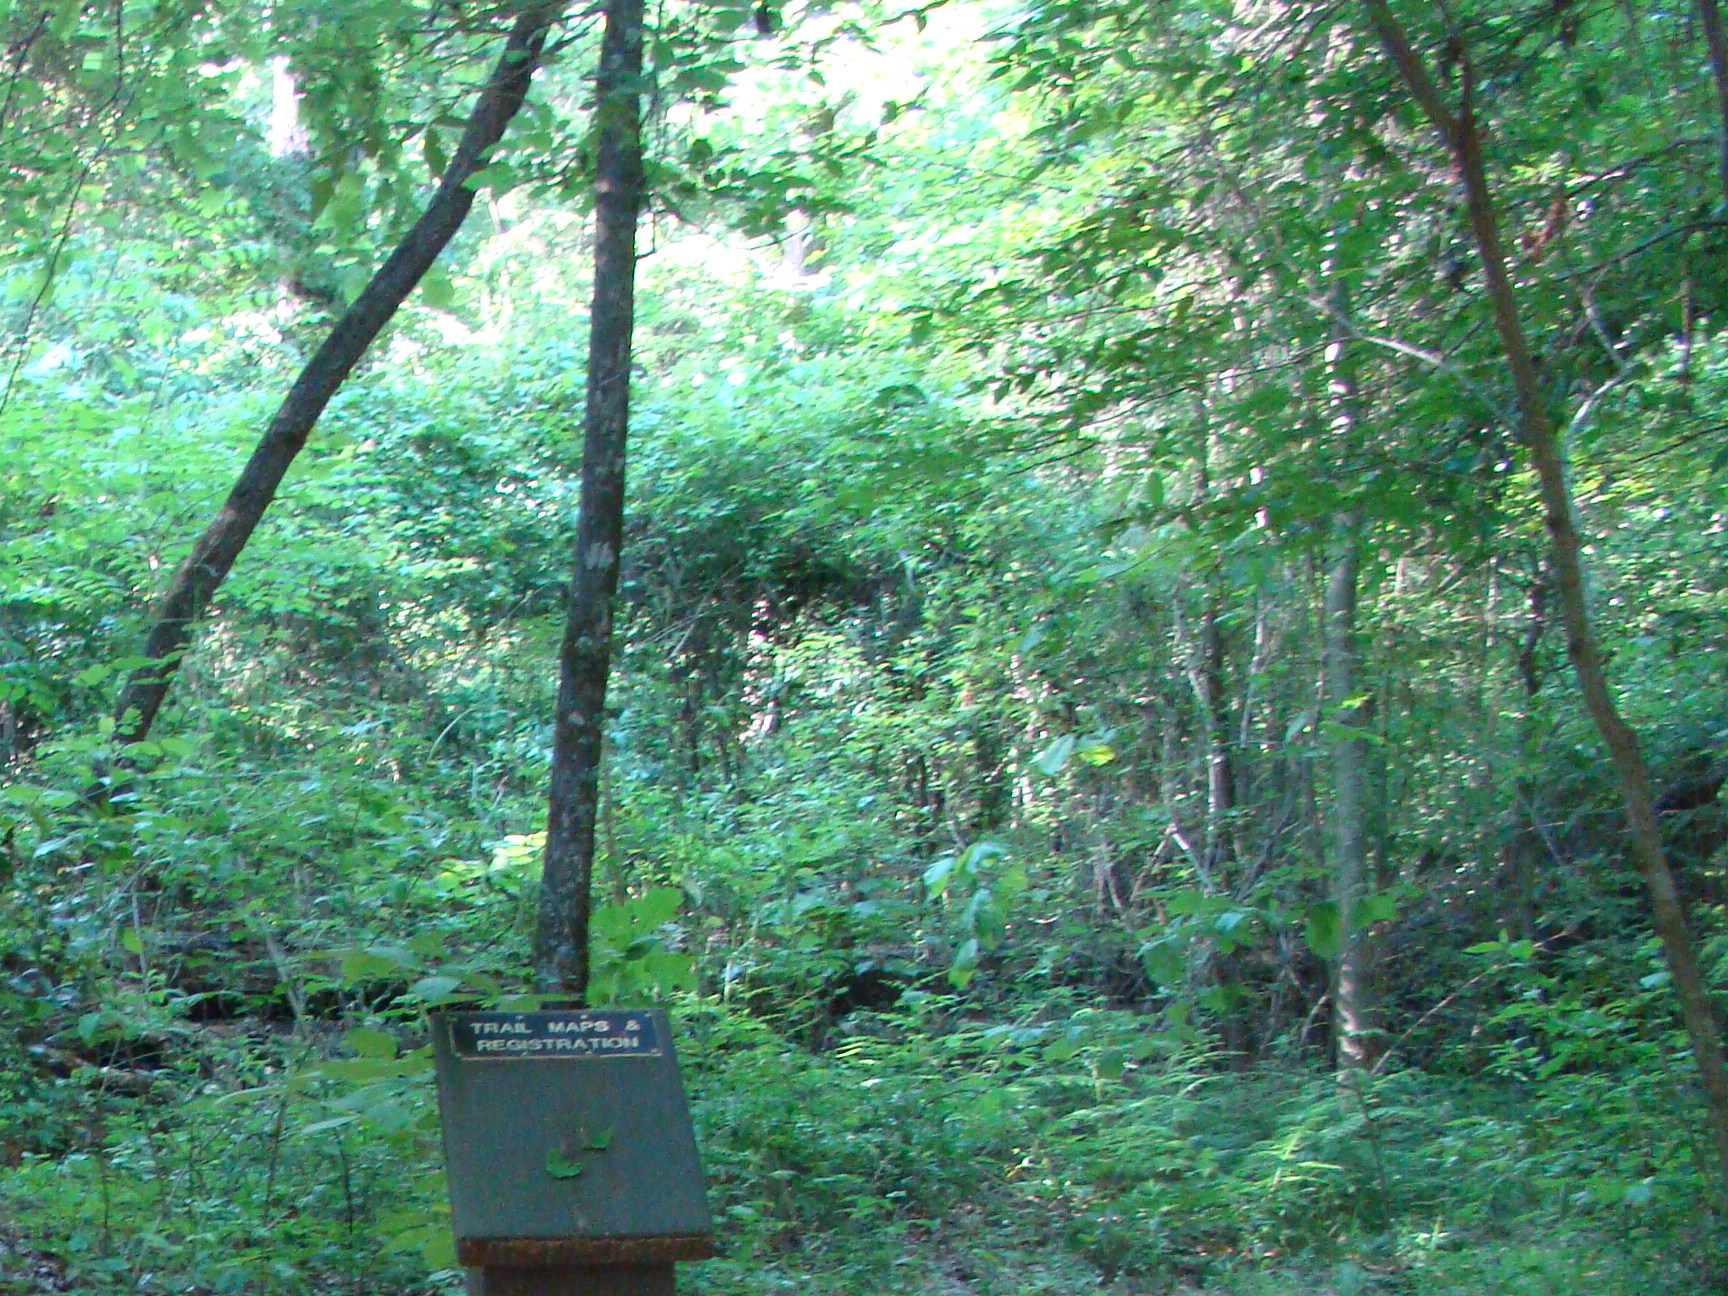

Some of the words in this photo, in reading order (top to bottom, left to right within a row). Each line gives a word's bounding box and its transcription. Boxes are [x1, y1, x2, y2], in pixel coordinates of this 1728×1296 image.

[470, 1022, 532, 1035] TRAIL
[547, 1020, 610, 1033] MAPS
[625, 1019, 641, 1031] &
[476, 1037, 640, 1052] REGISTRATION
